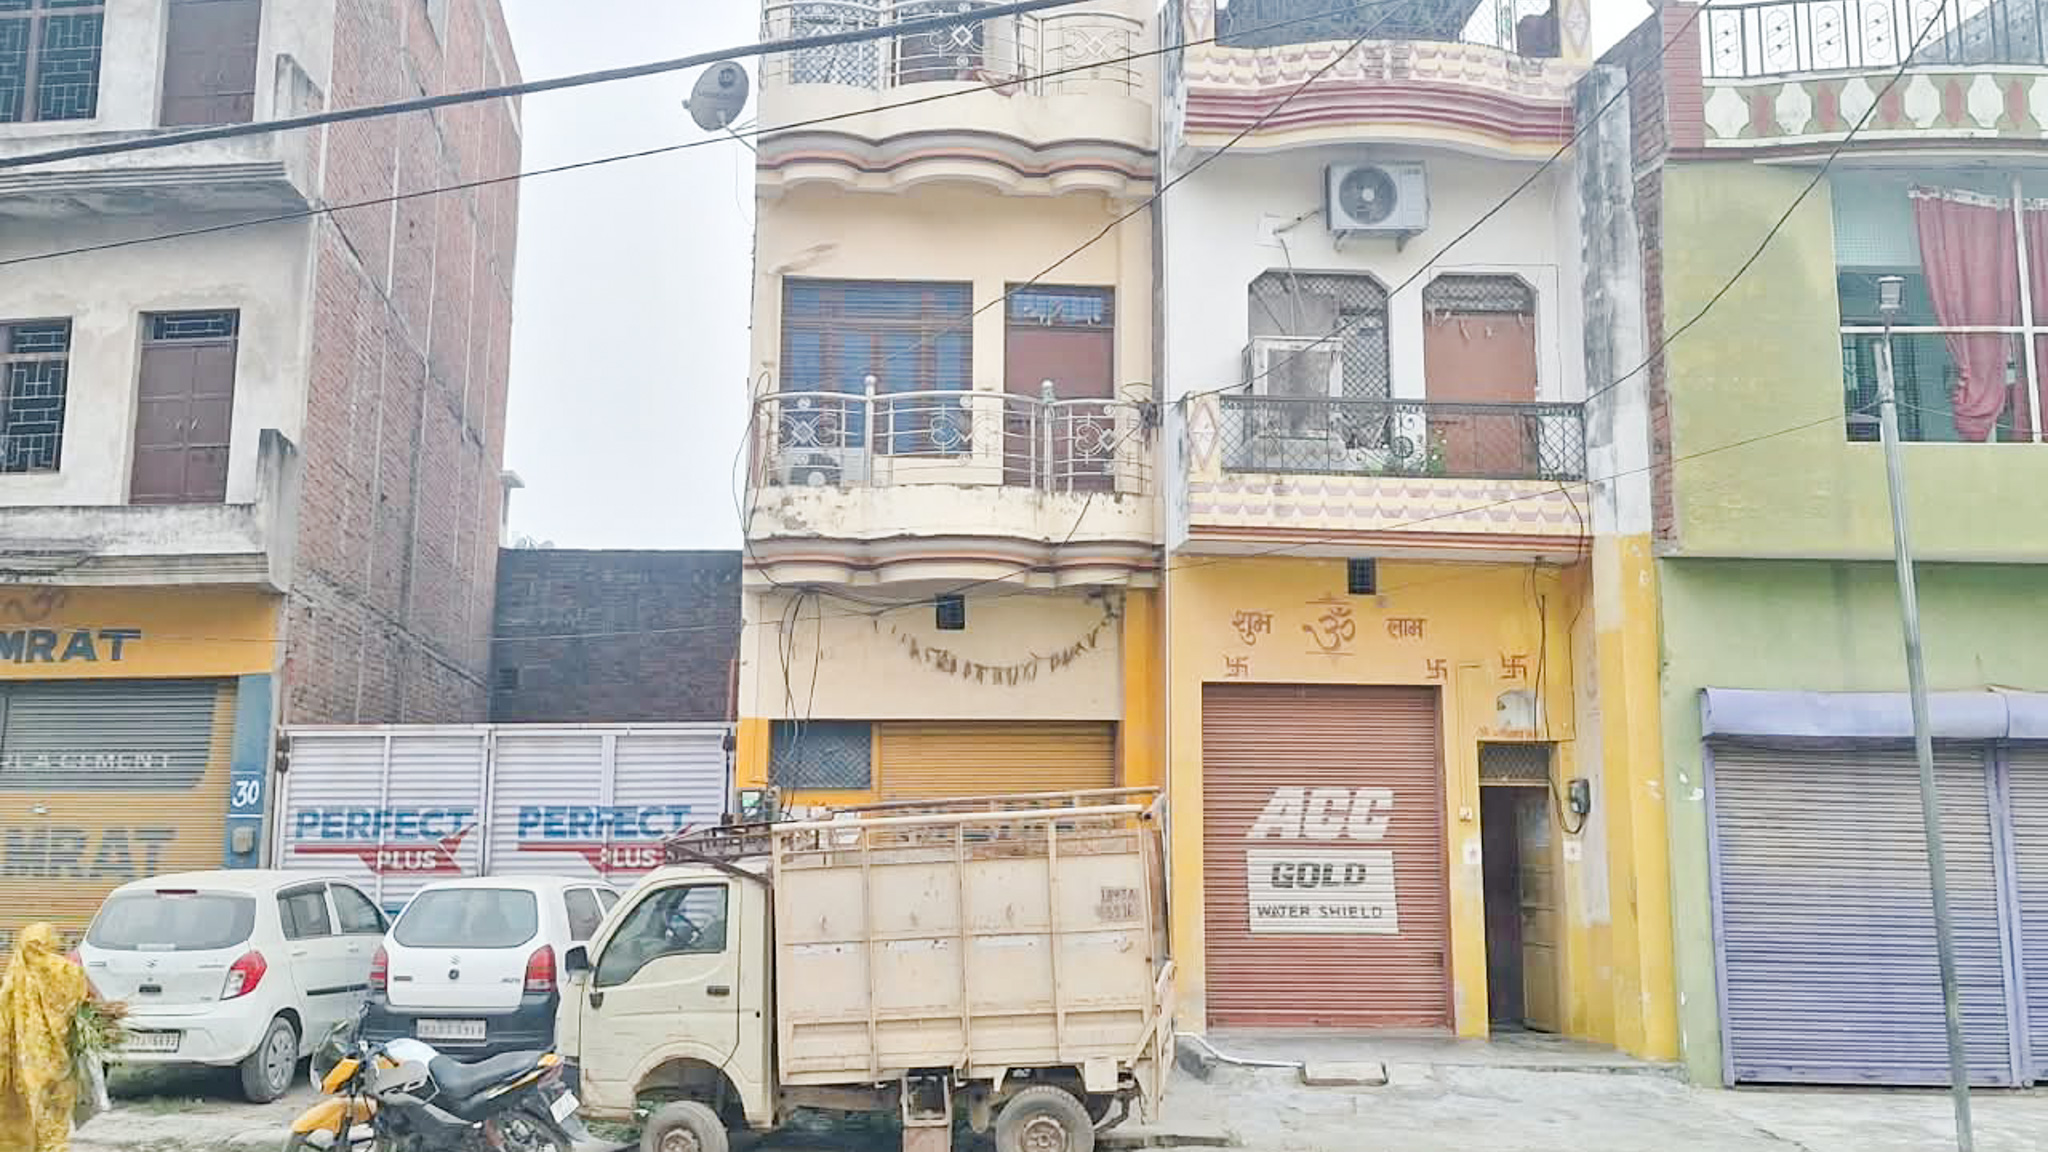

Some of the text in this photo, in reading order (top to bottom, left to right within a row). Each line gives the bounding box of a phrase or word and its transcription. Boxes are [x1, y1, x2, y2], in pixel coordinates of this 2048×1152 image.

[0, 628, 142, 663] MRAT
[231, 780, 260, 807] 30
[295, 806, 476, 839] PERFECT
[517, 805, 692, 839] PERFECT
[1246, 787, 1394, 840] ACC
[376, 850, 436, 870] PLUS
[1271, 862, 1367, 888] GOLD
[1256, 905, 1383, 919] WATER SHIELD
